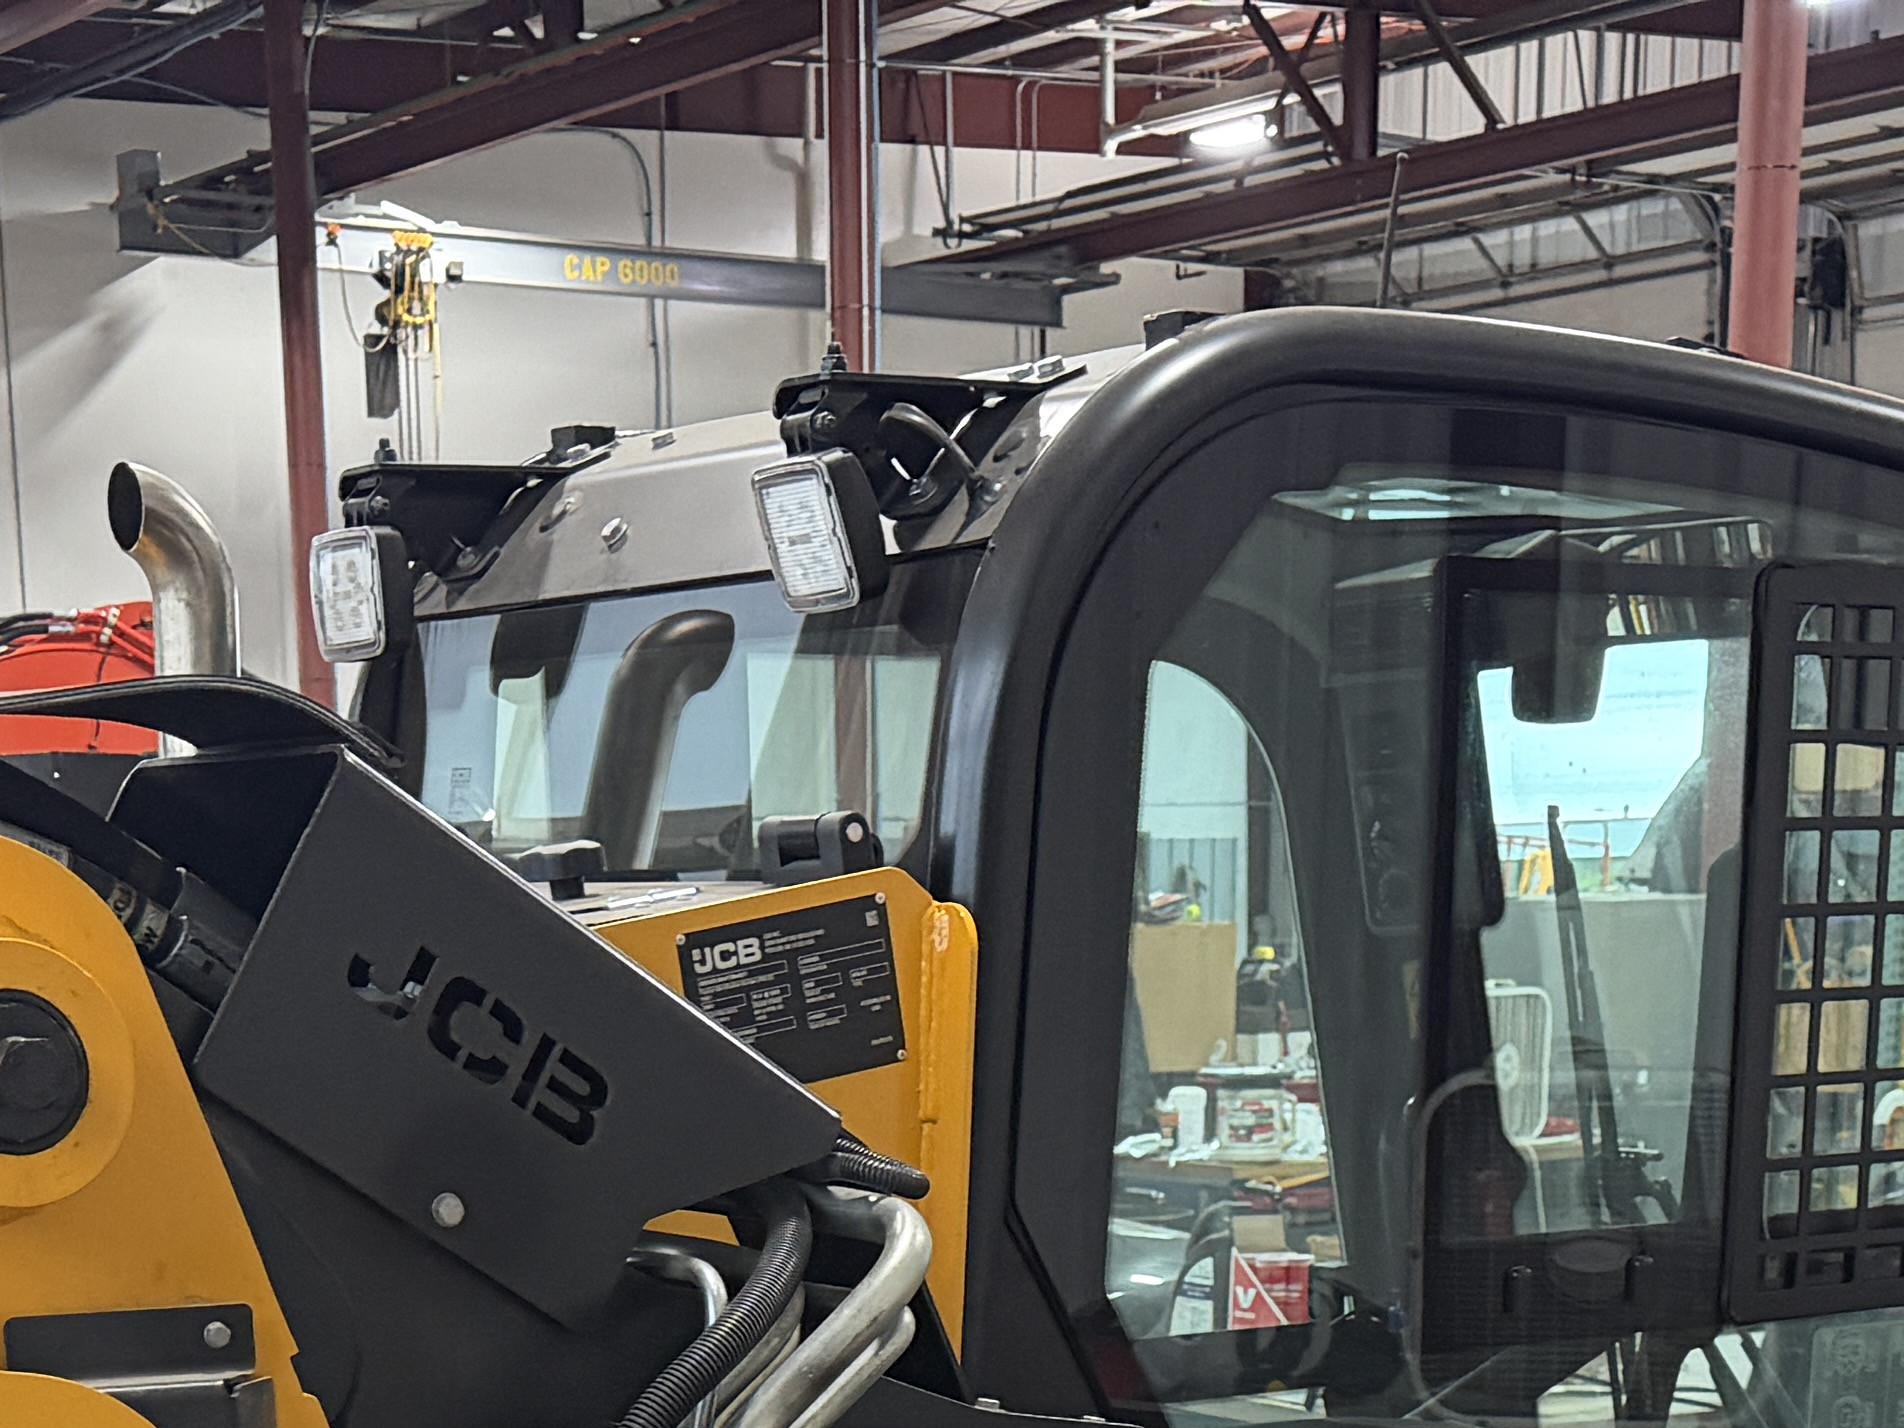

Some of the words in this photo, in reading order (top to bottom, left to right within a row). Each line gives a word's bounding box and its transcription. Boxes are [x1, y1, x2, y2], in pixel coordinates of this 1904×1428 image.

[564, 254, 611, 282] CAP
[618, 258, 679, 288] 6000
[691, 936, 763, 974] JCB
[347, 945, 609, 1146] JCB
